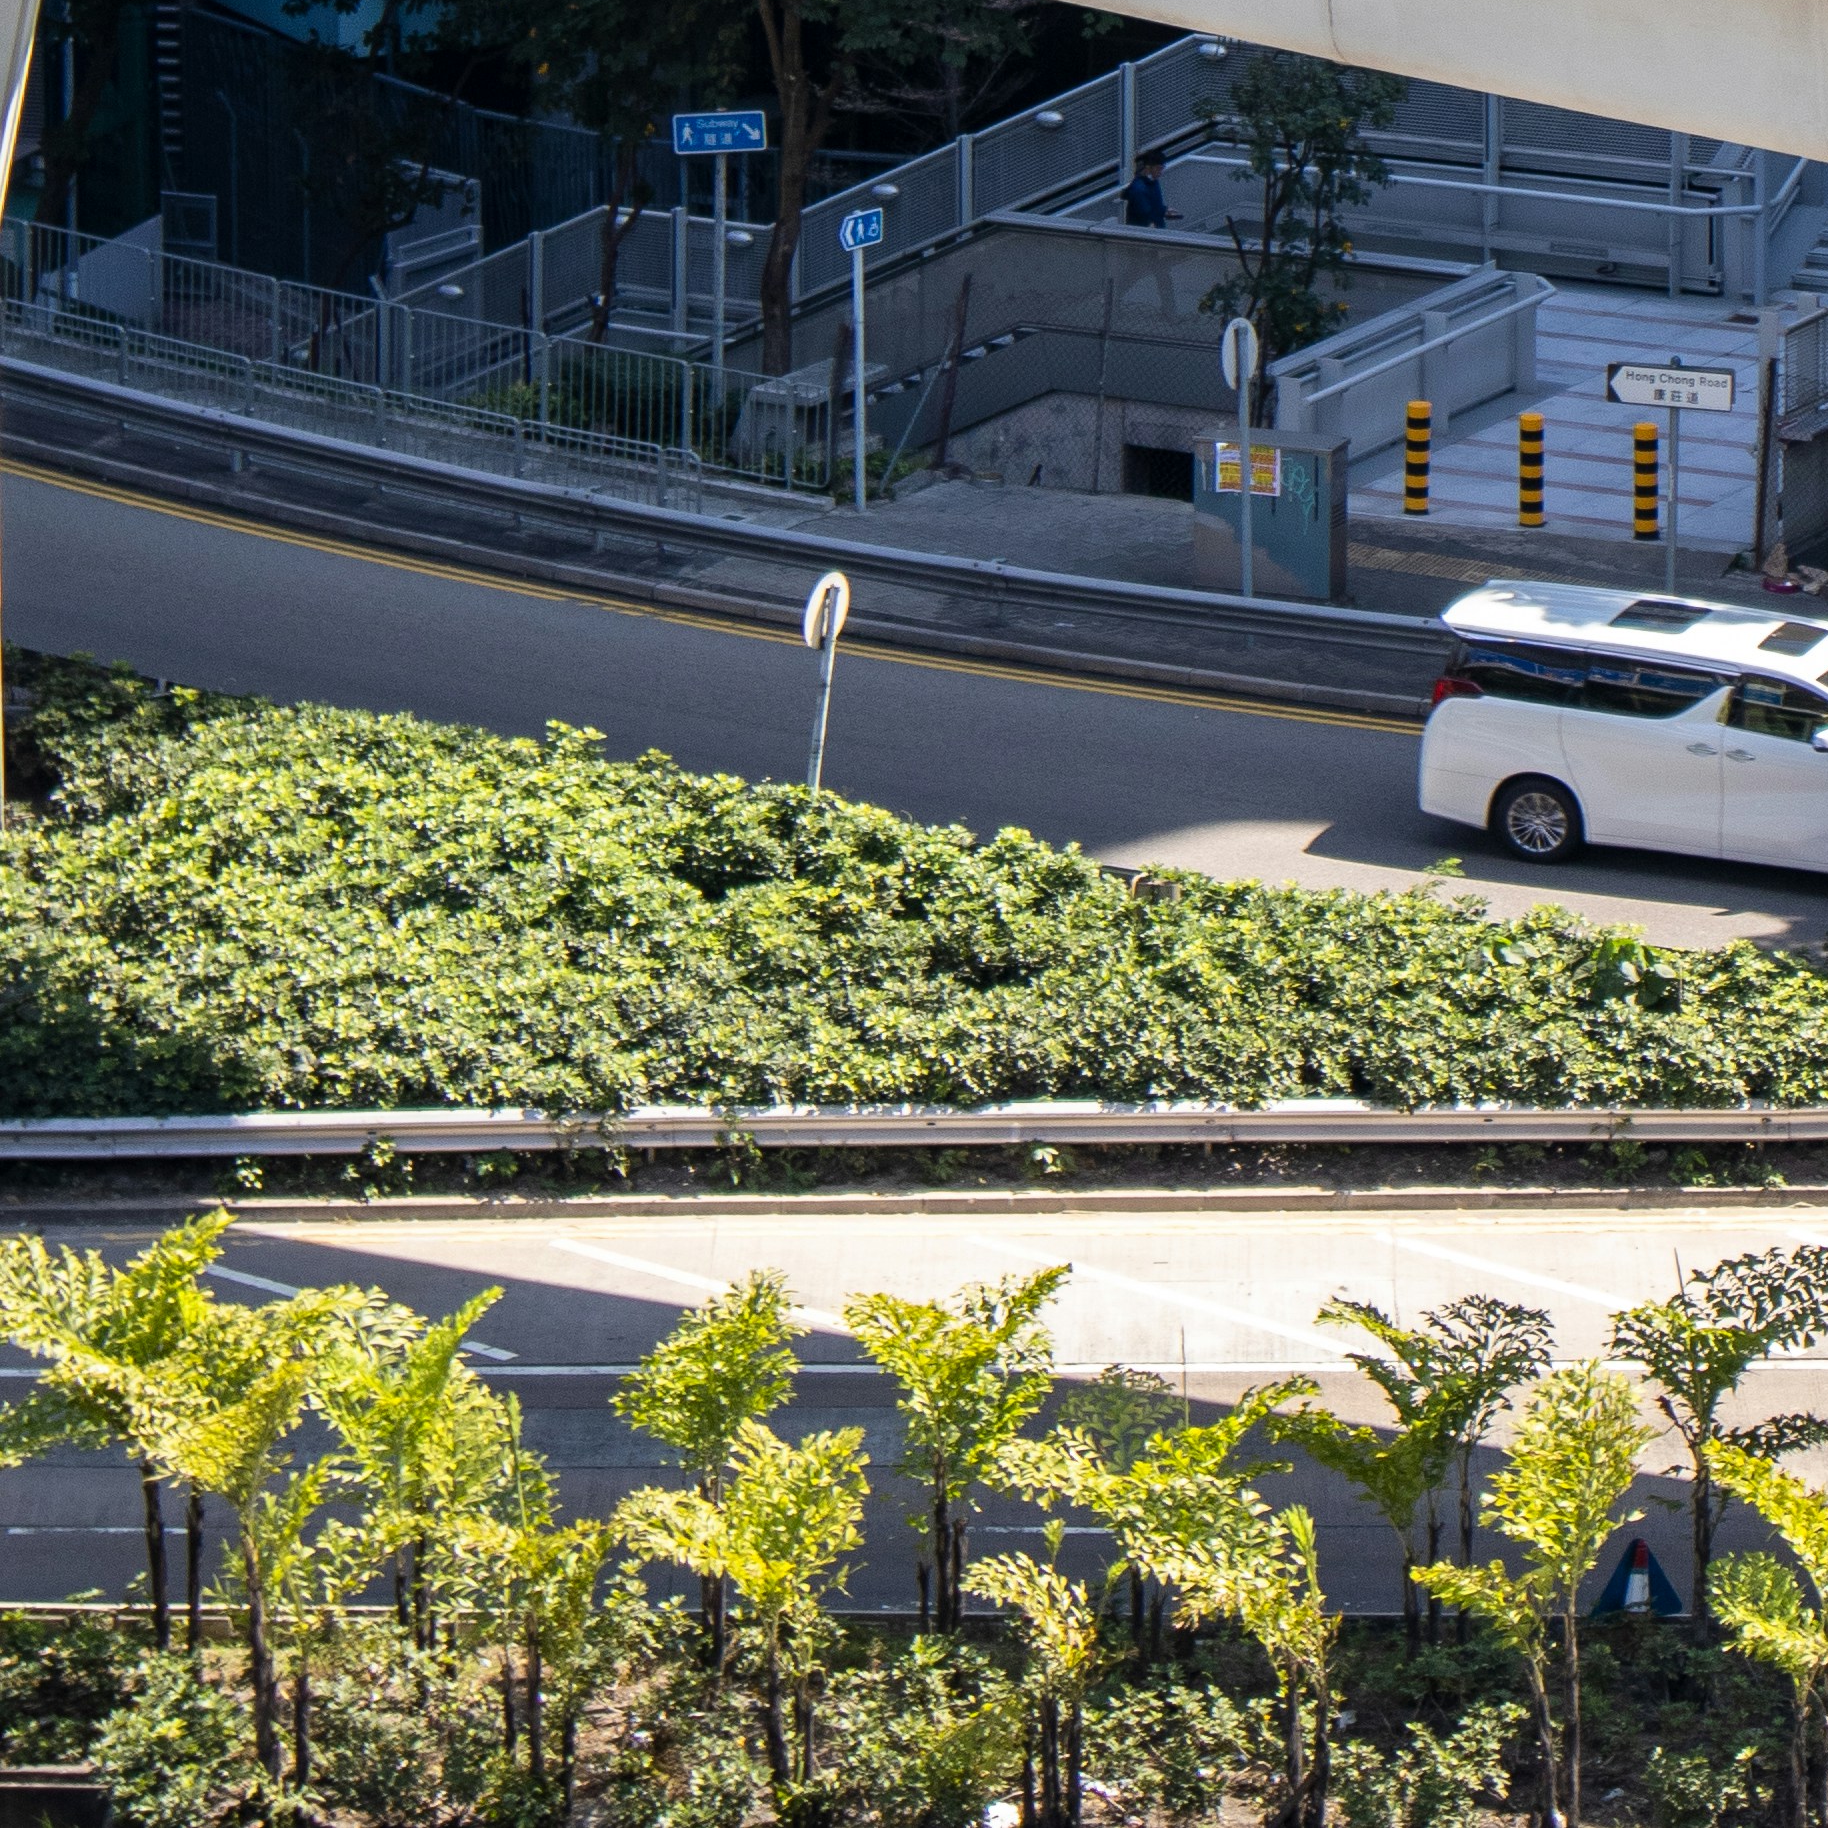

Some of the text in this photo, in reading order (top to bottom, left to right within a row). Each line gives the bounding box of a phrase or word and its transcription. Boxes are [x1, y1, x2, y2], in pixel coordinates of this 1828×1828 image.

[696, 118, 739, 129] Subway
[1626, 370, 1729, 389] Hong Chong Road
